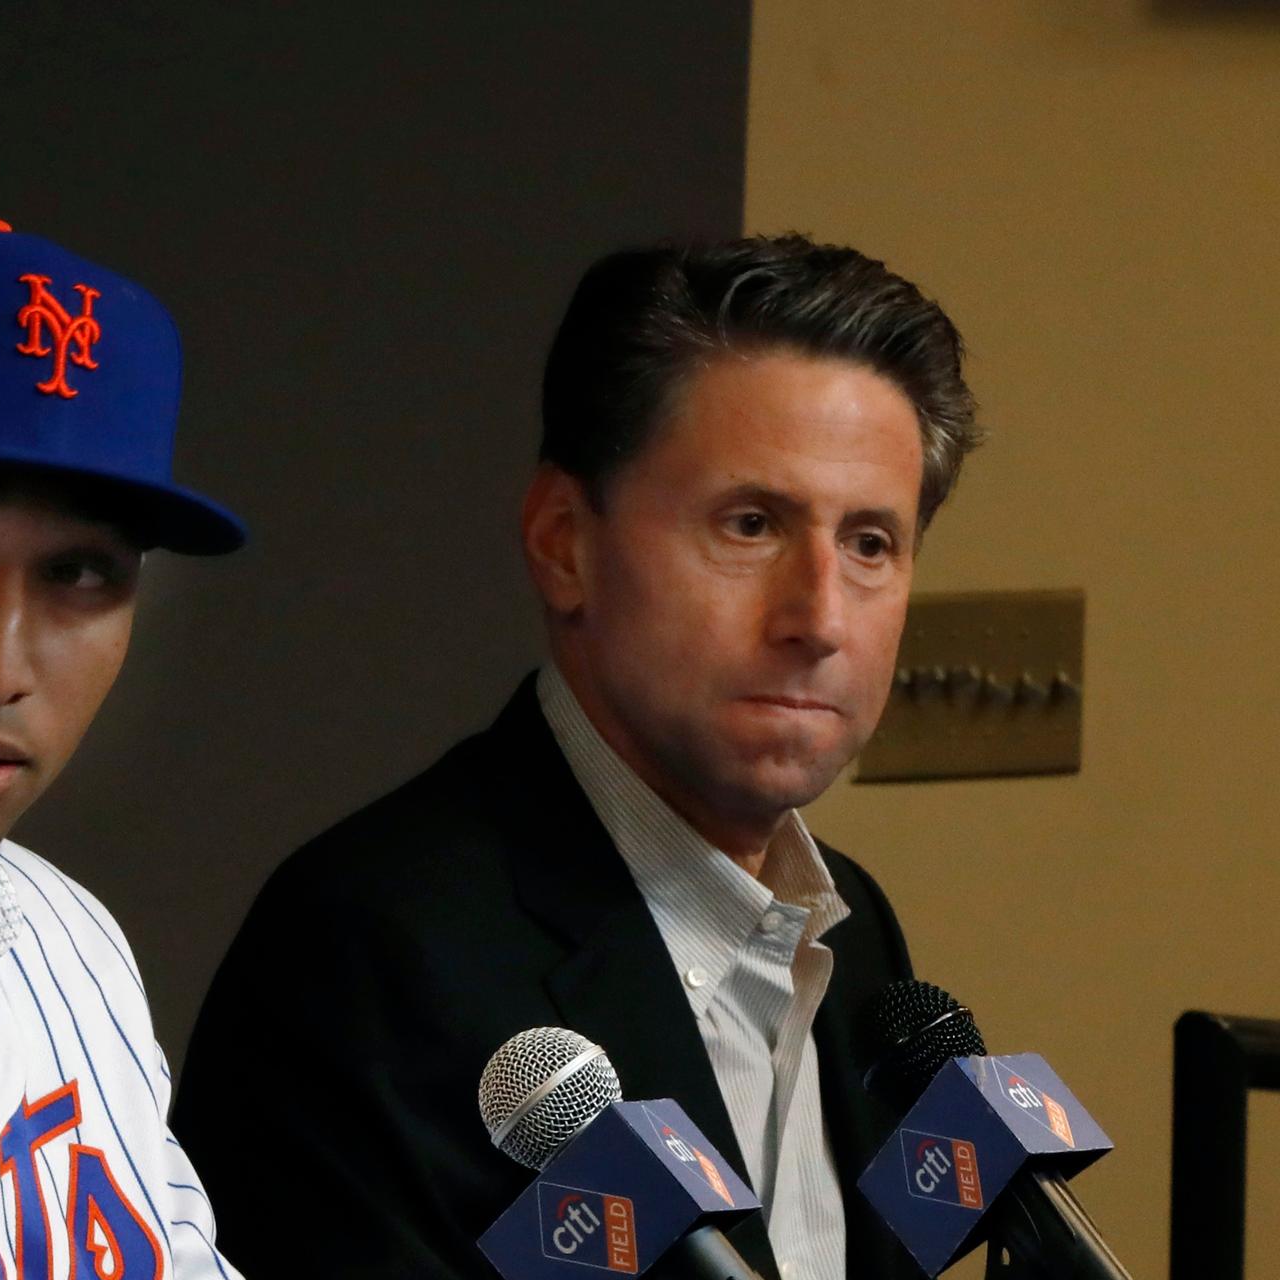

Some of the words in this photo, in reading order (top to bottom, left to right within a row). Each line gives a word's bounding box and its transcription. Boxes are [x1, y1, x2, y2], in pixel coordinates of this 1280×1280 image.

[15, 272, 102, 399] NY
[1008, 1083, 1043, 1109] citi
[915, 1146, 952, 1194] citi
[960, 1146, 977, 1204] FIELD
[553, 1201, 601, 1255] citi
[610, 1202, 631, 1267] FIELD
